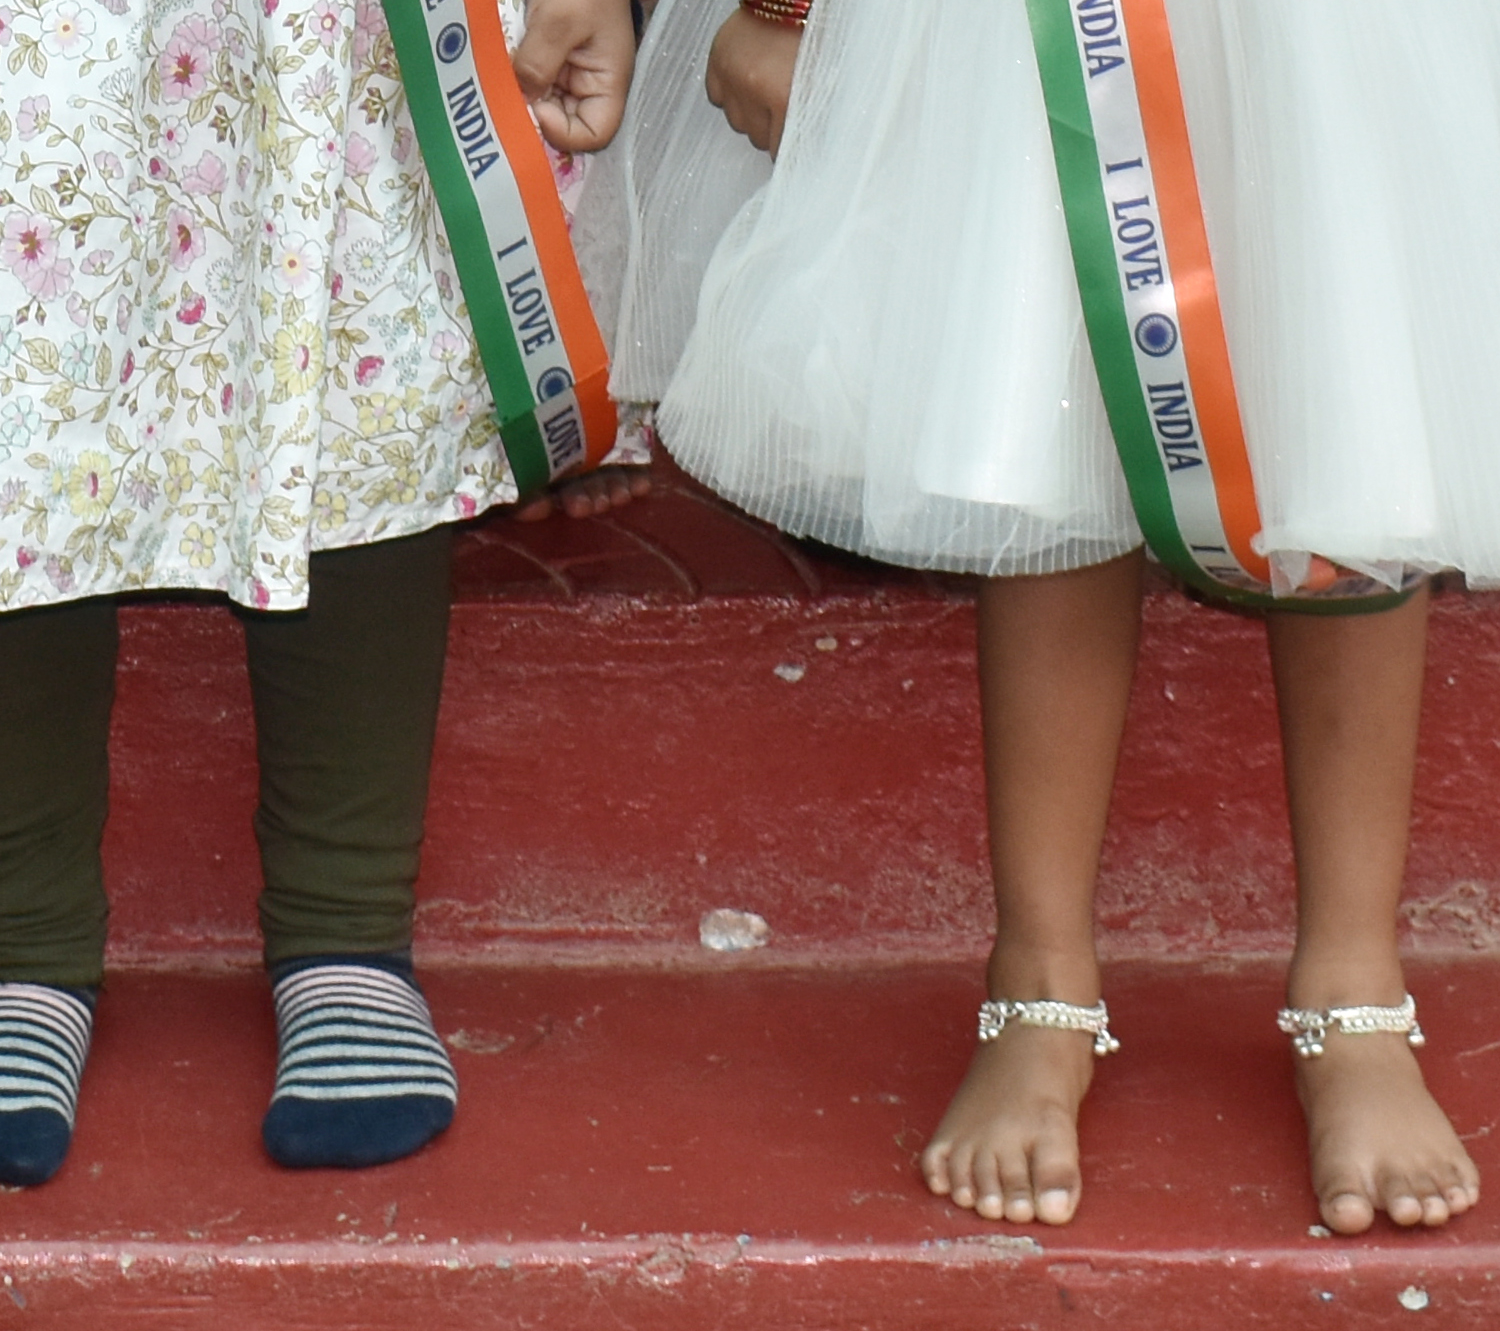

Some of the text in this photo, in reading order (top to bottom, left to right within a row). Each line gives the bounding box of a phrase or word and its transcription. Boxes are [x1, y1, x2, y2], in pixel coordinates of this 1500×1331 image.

[446, 76, 501, 182] INDIA
[497, 236, 529, 261] I
[505, 267, 556, 356] LOVE
[1104, 157, 1203, 474] I LOVE INDIA
